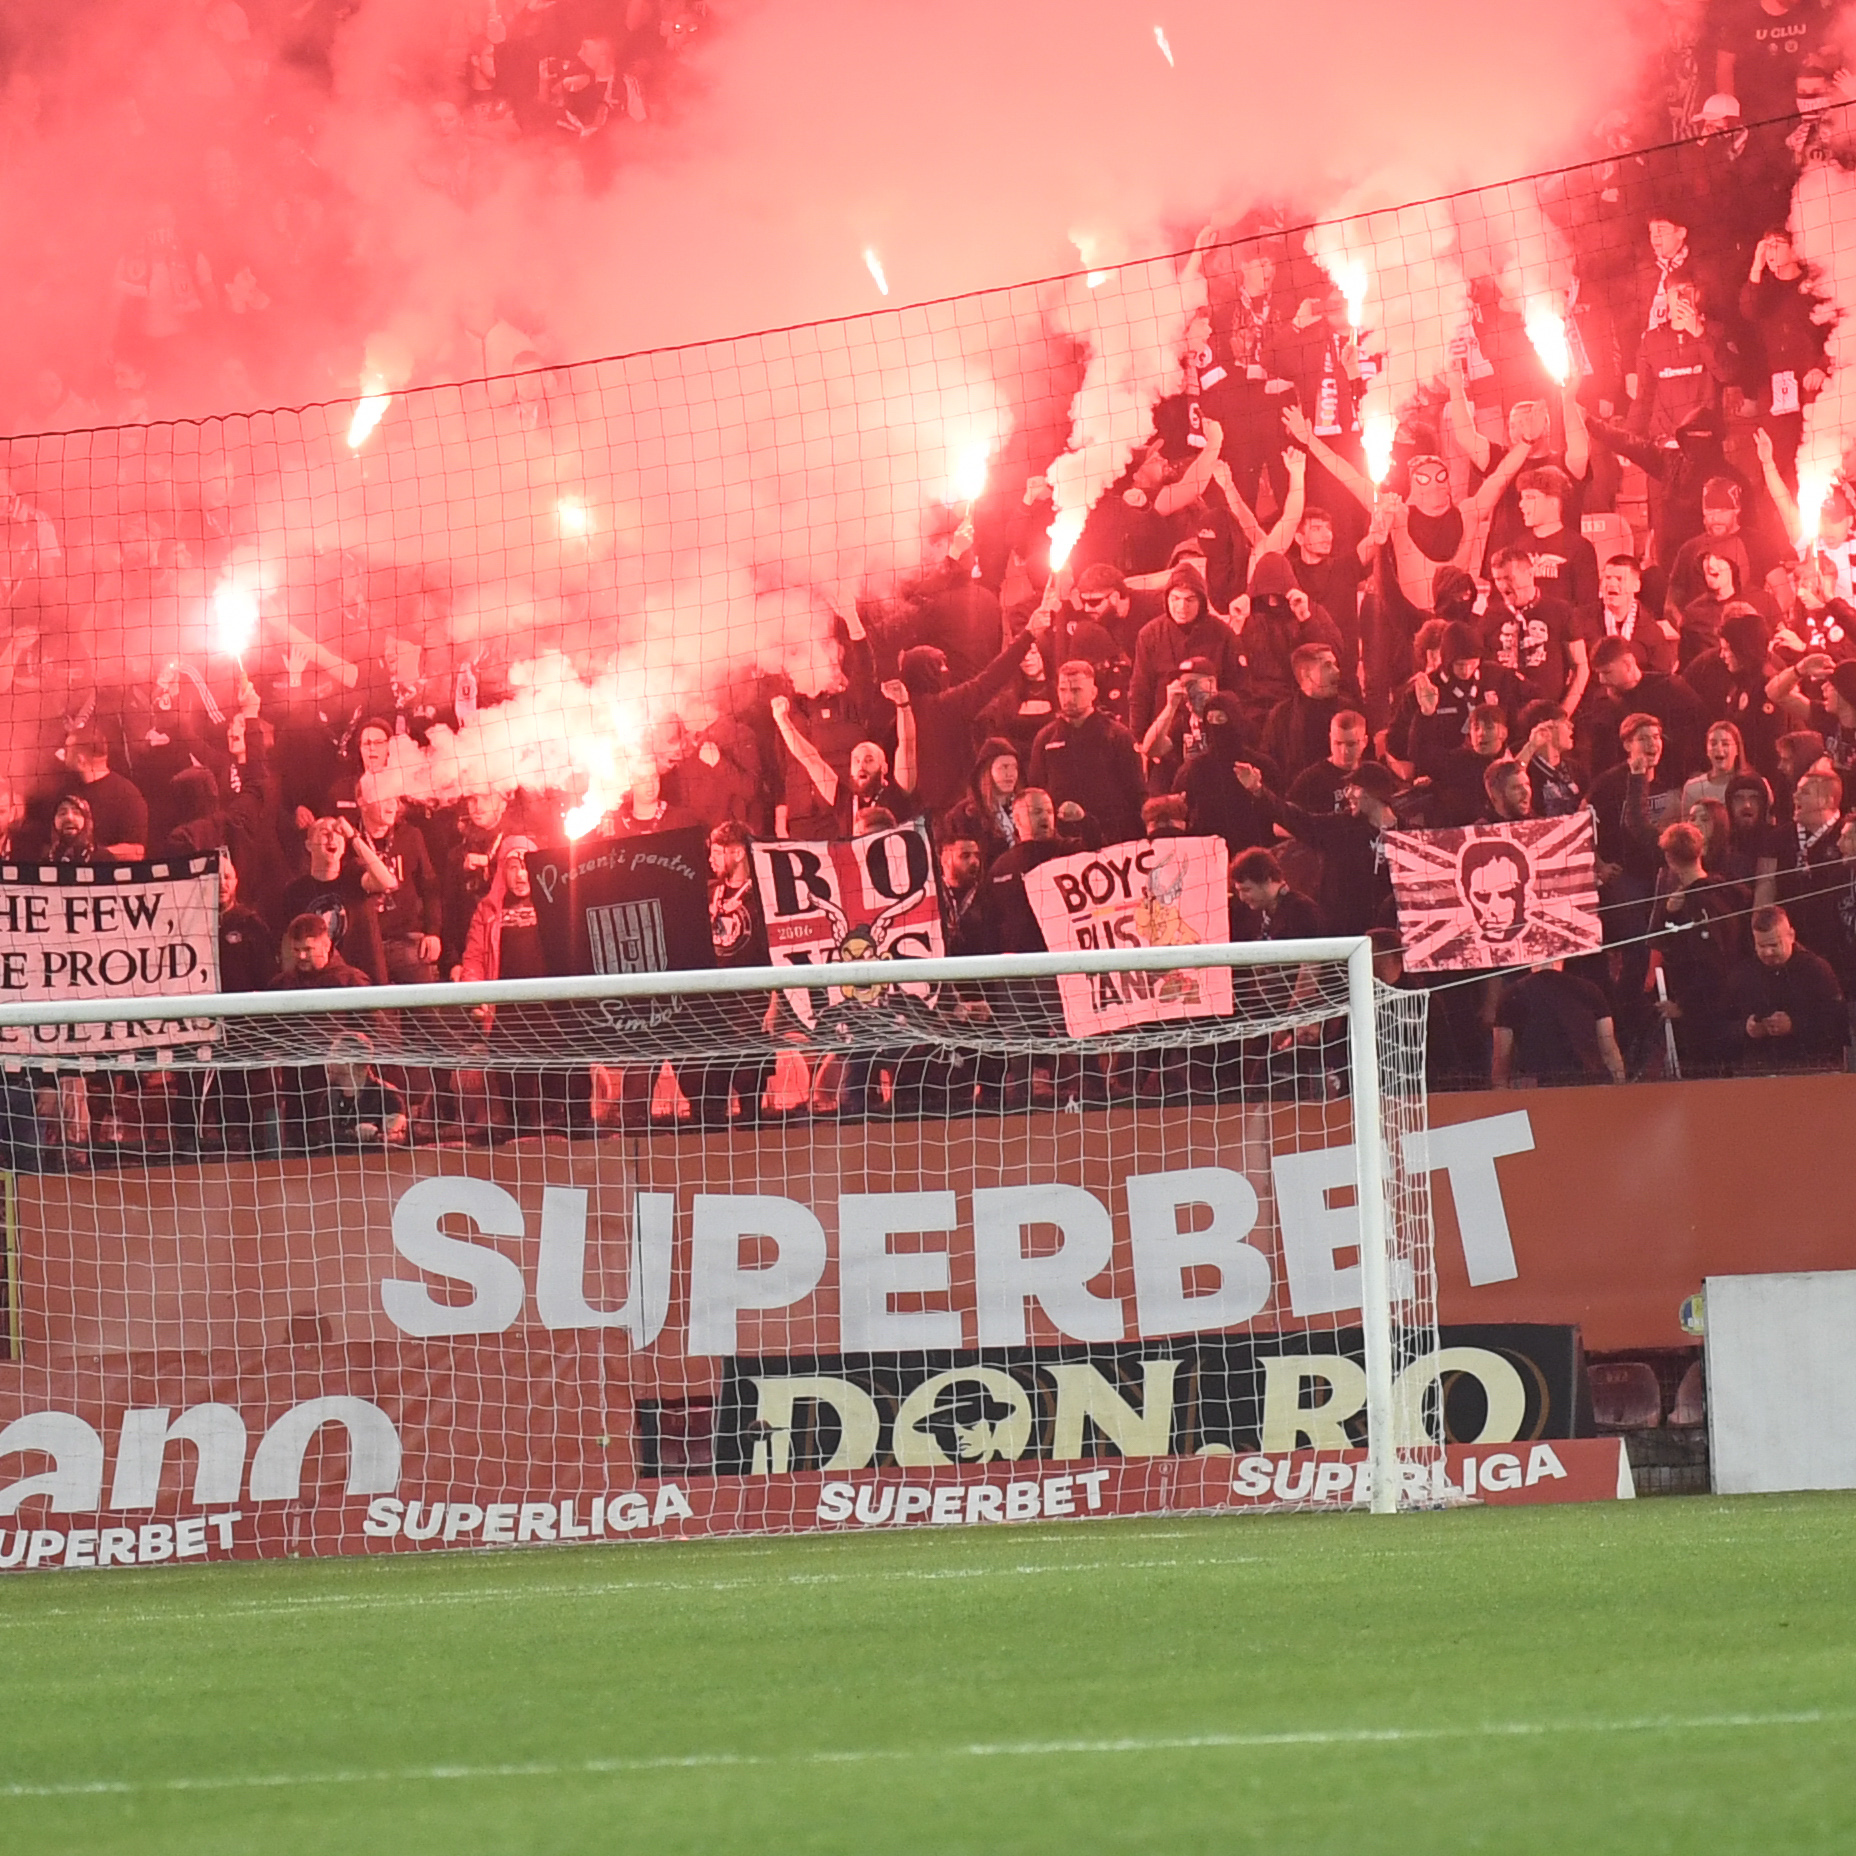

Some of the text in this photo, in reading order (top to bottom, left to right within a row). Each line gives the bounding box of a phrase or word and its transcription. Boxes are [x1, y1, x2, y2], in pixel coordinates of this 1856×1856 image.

[1756, 28, 1768, 40] U
[630, 849, 697, 881] pentru
[62, 892, 175, 934] FEW,
[41, 942, 209, 988] PROUD,
[380, 1111, 1536, 1358] SUPERBET
[363, 1483, 693, 1545] SUPERLIGA
[818, 1470, 1110, 1526] SUPERBET
